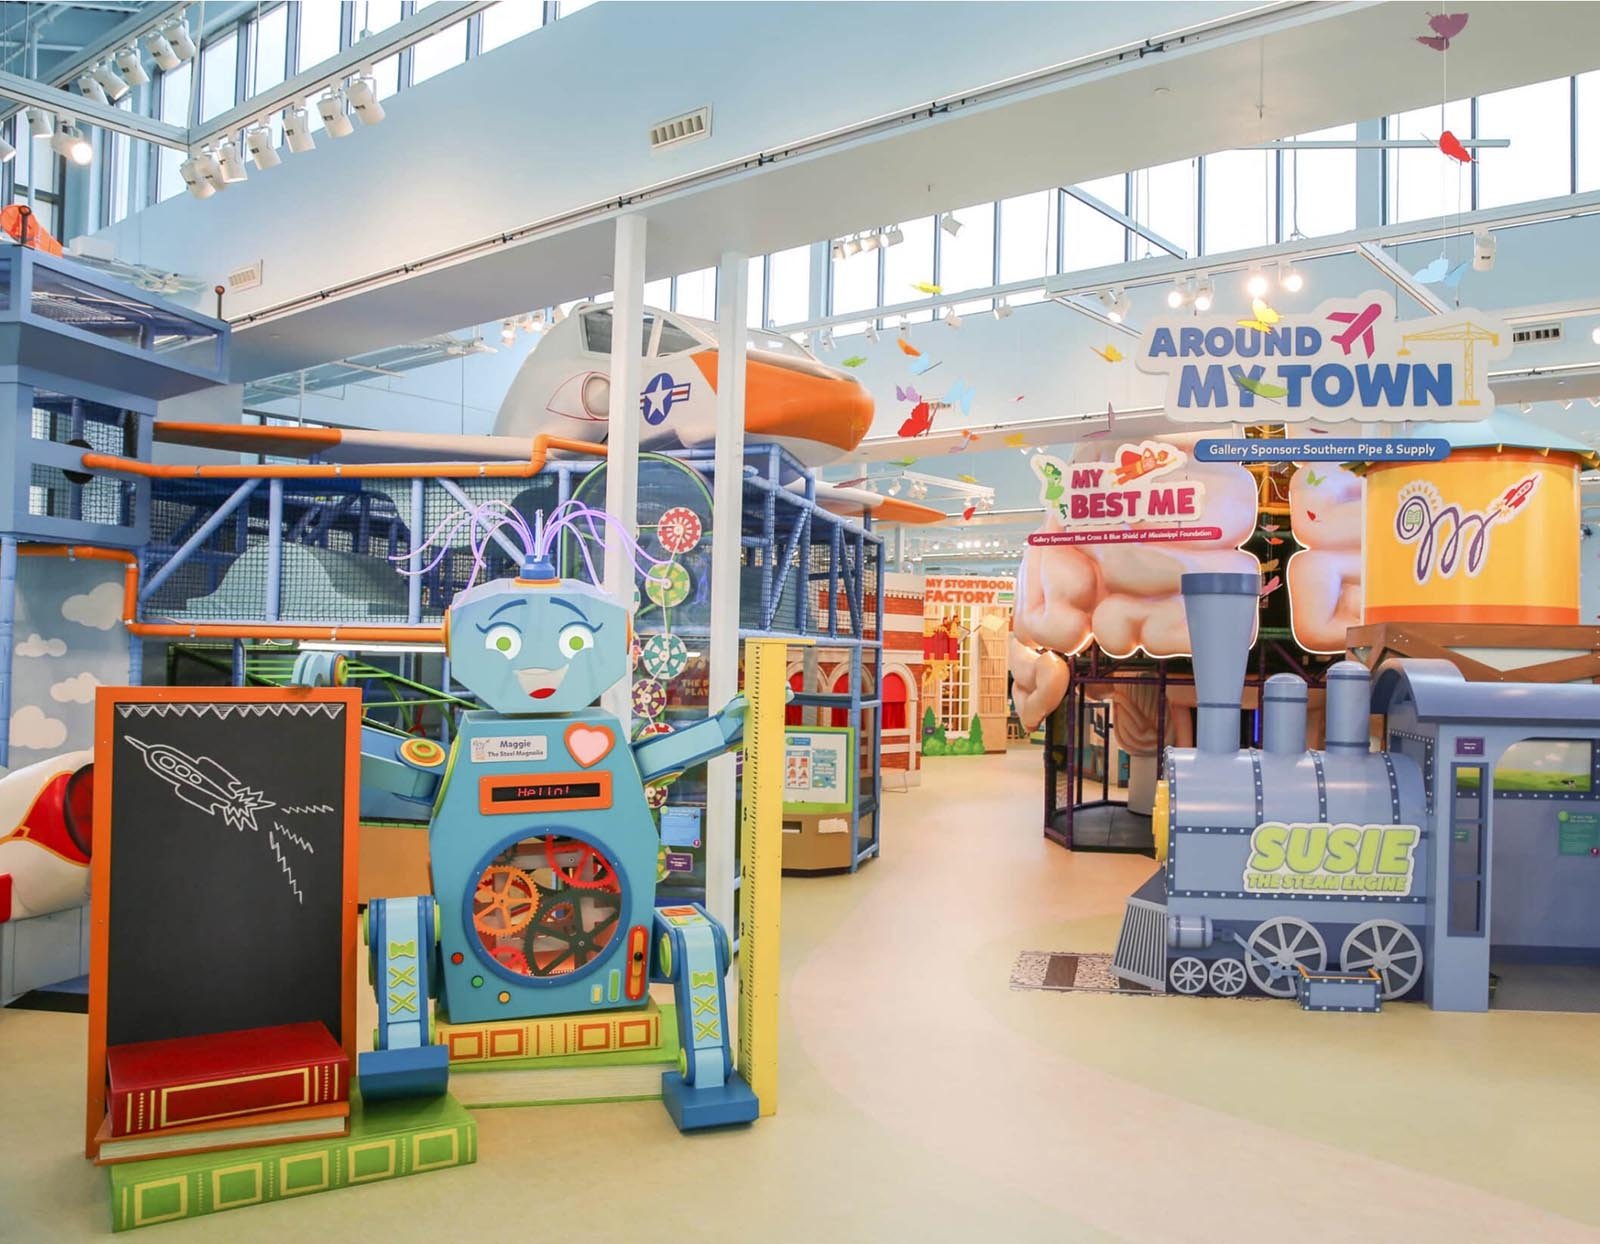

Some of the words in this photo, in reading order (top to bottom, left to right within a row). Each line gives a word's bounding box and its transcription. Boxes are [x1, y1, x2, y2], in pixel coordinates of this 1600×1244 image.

[1148, 326, 1322, 358] AROUND
[1178, 364, 1266, 408] MY
[1277, 363, 1453, 407] TOWN
[1209, 444, 1248, 456] Gallery
[1251, 444, 1300, 456] Sponsor:
[1303, 443, 1355, 455] Southern
[1358, 444, 1382, 456] Pipe
[1385, 444, 1394, 454] &
[1396, 444, 1435, 456] Supply
[1071, 469, 1103, 489] MY
[1071, 491, 1141, 519] BEST
[1147, 488, 1195, 516] ME
[925, 579, 943, 588] MY
[945, 579, 1014, 590] STORYBOOK
[925, 591, 995, 604] FACTORY
[500, 740, 531, 749] Maggie
[516, 750, 543, 758] Magnolia
[1250, 826, 1416, 874] SUSIE
[1247, 873, 1280, 889] THE
[1281, 874, 1339, 890] STEAM
[1341, 877, 1408, 892] ENGINE
